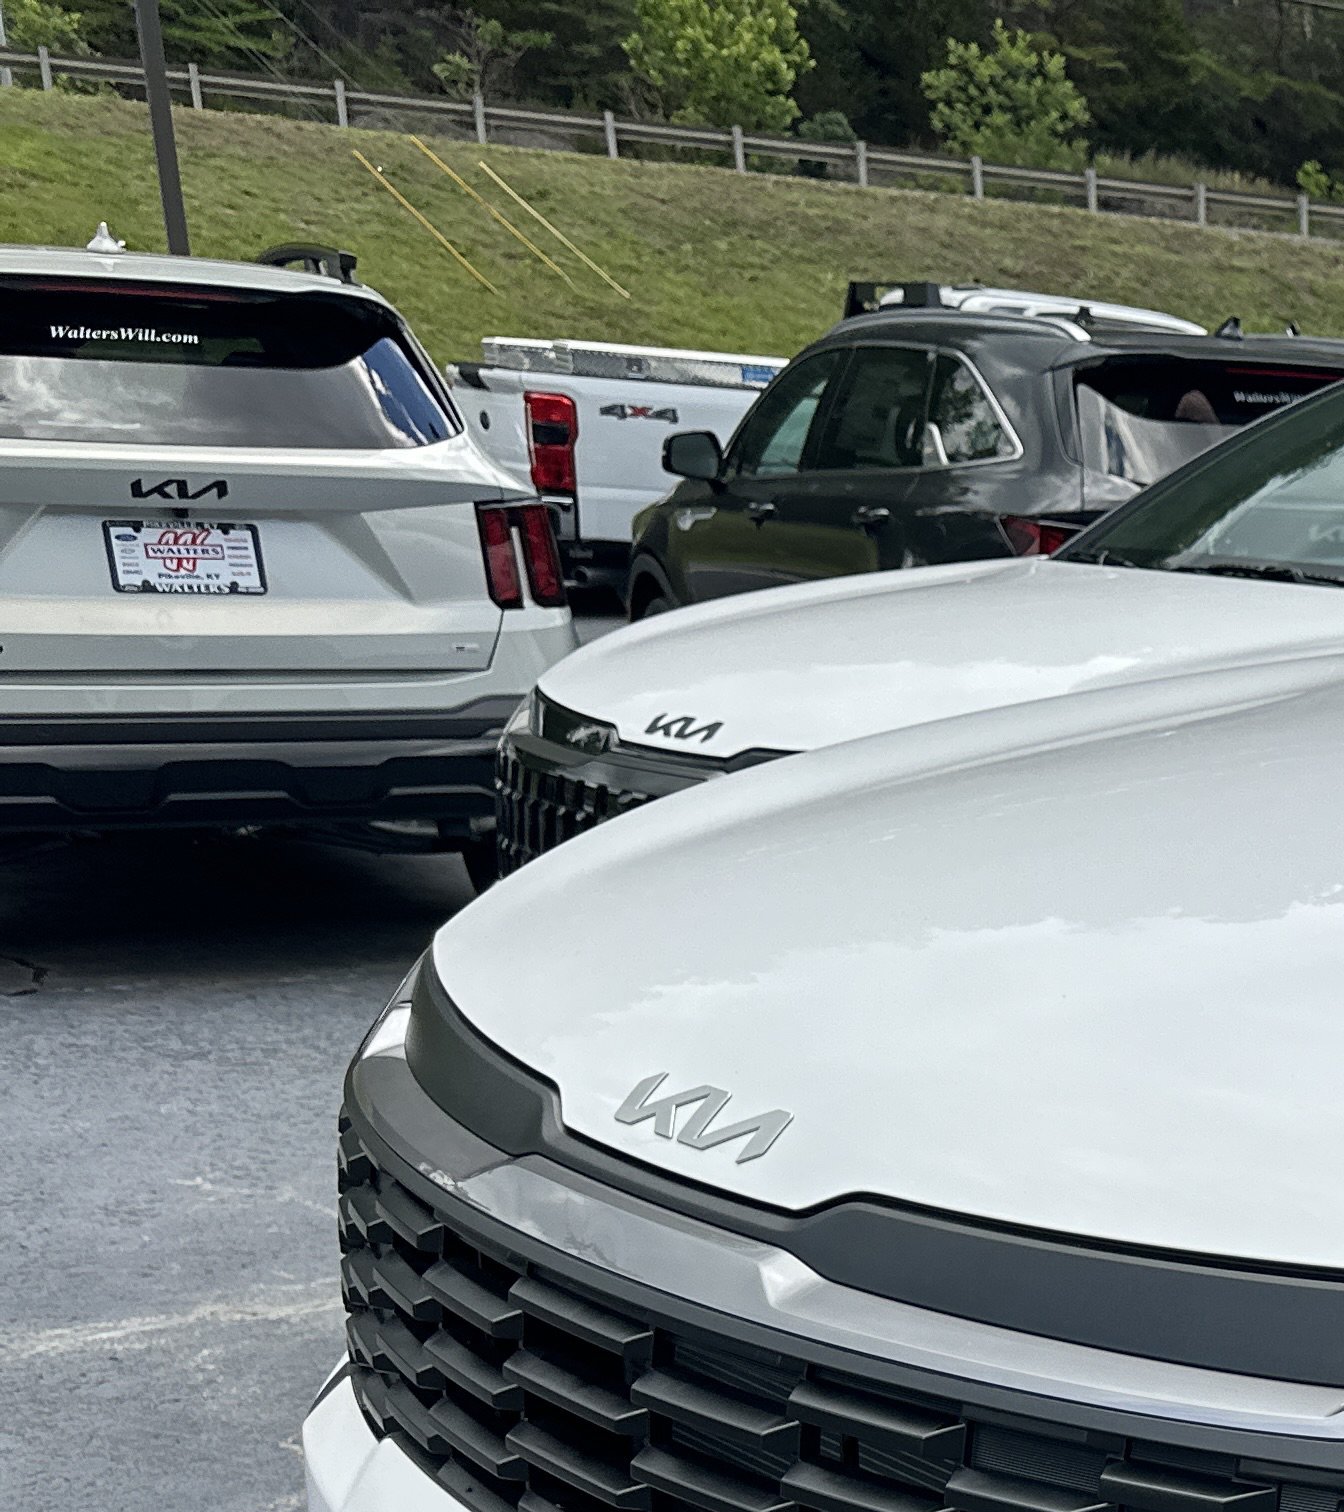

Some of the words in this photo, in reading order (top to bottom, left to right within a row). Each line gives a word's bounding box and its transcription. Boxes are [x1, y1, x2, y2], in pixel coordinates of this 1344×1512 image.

[50, 325, 200, 344] WaltersWill.com
[130, 478, 229, 500] KIA
[150, 545, 220, 556] WALTERS
[154, 582, 230, 593] WALTERS
[644, 712, 724, 744] KIA
[614, 1072, 794, 1164] KIA
